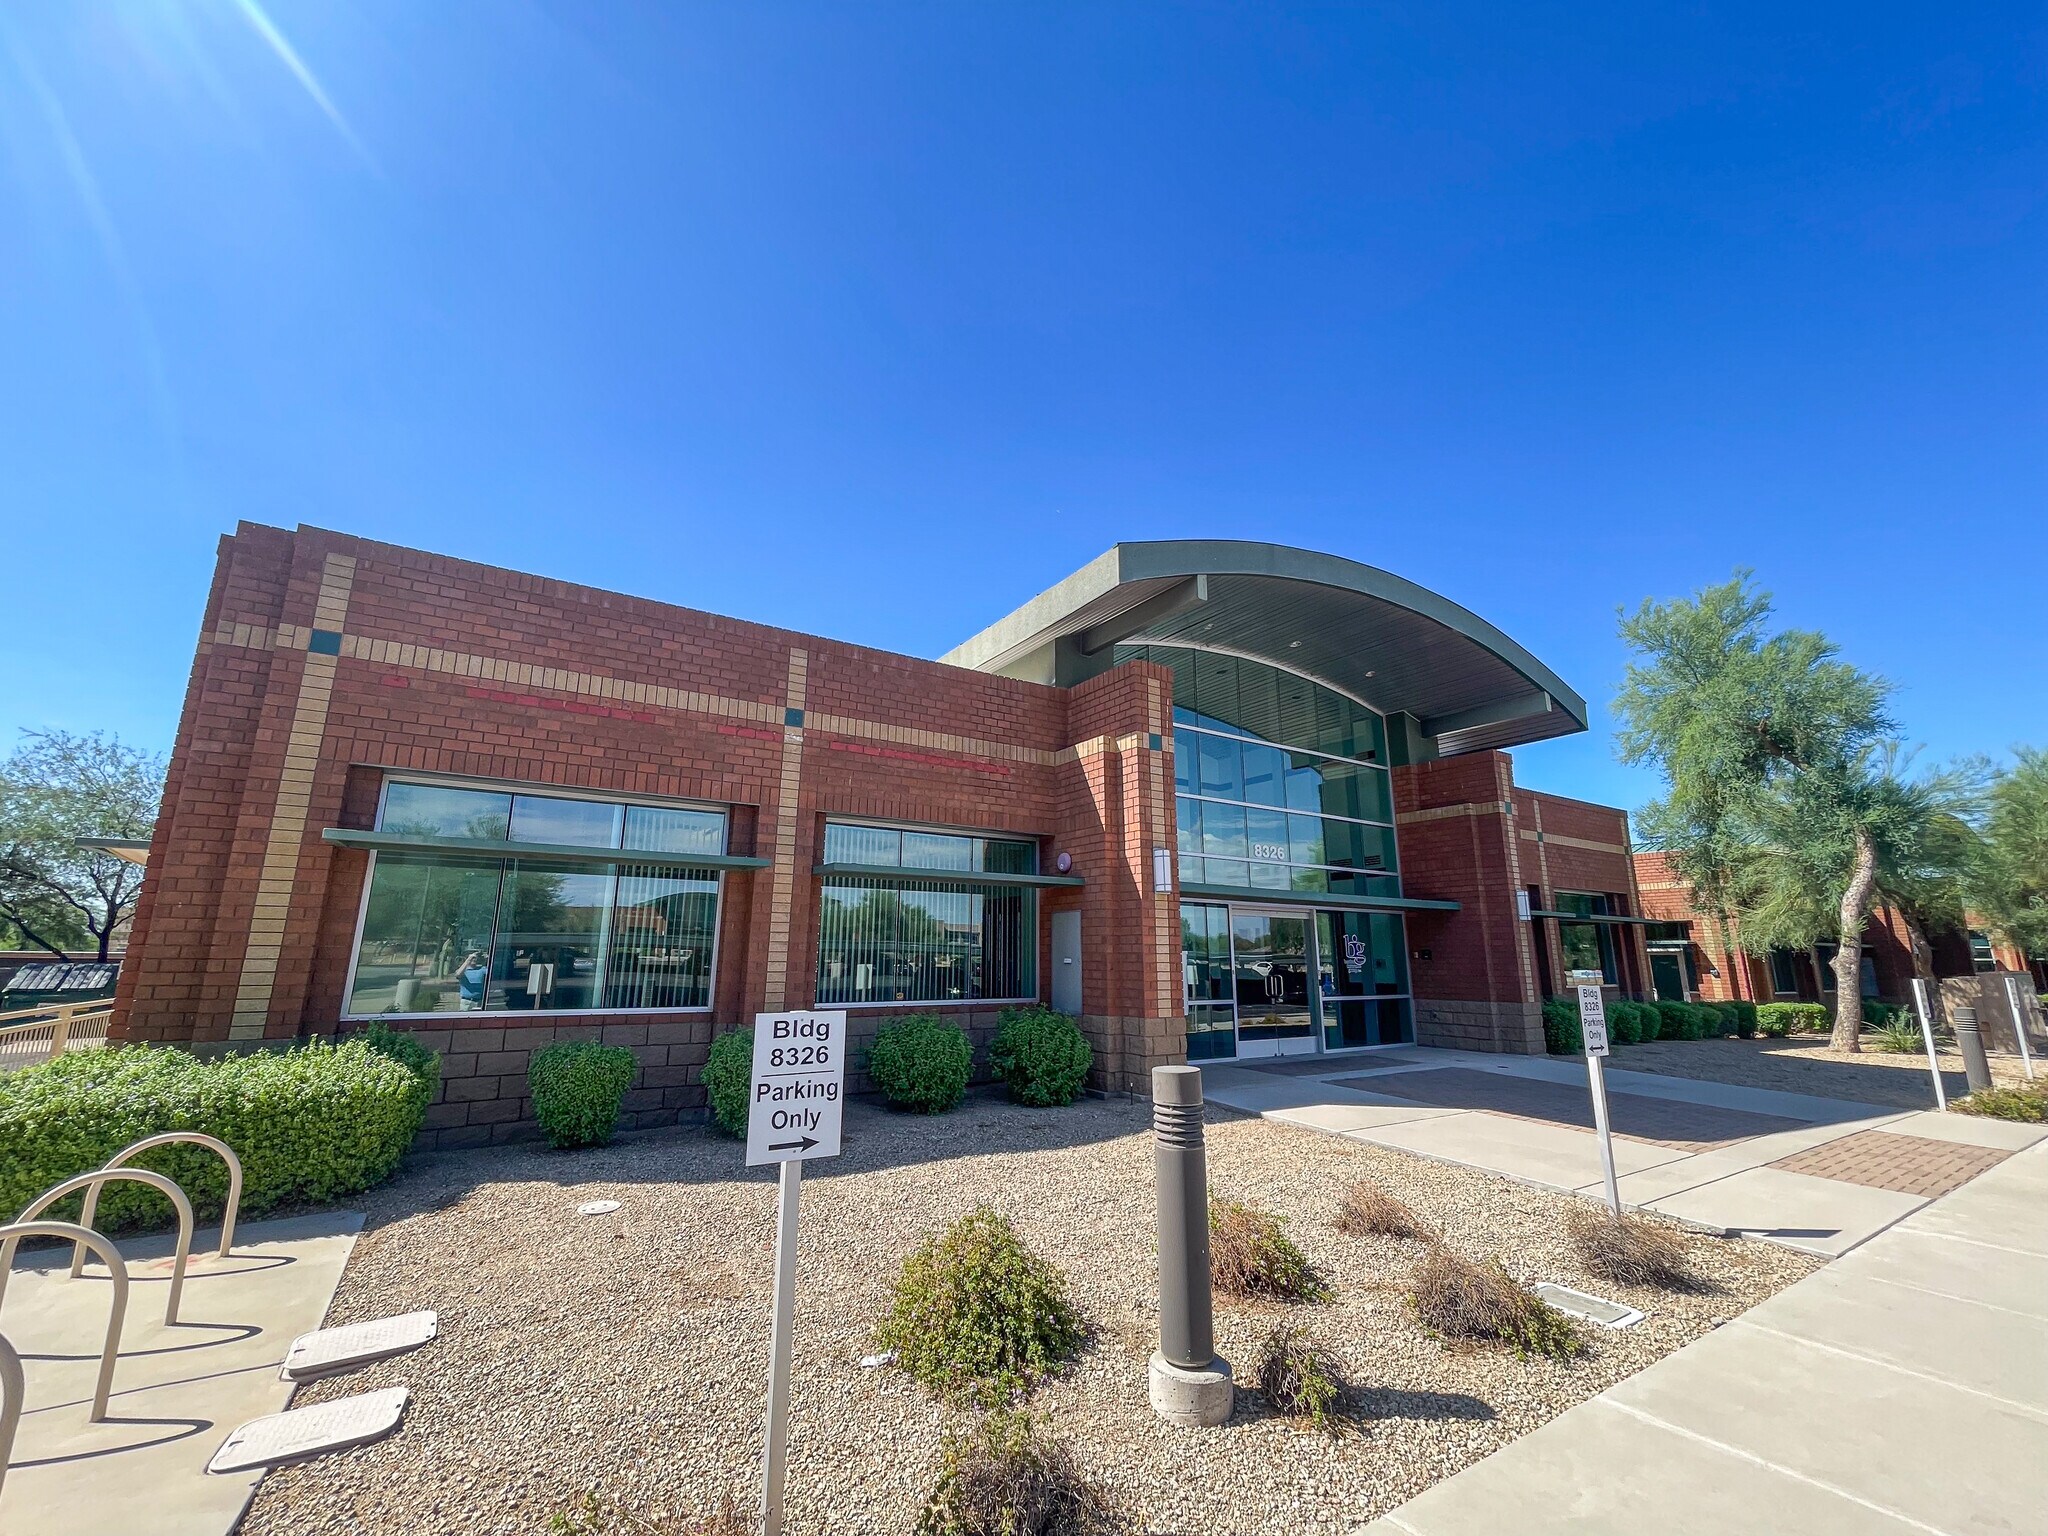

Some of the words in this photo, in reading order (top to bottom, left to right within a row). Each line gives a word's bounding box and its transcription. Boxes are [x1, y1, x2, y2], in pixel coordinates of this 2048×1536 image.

[1254, 844, 1285, 860] 8326
[1583, 988, 1598, 1000] Bldg
[1584, 1001, 1600, 1012] 8326
[773, 1019, 830, 1041] Bldg
[1584, 1018, 1604, 1028] Parking
[1588, 1030, 1602, 1040] Only
[770, 1046, 829, 1067] 8326
[756, 1079, 839, 1103] Parking
[771, 1108, 822, 1131] Only
